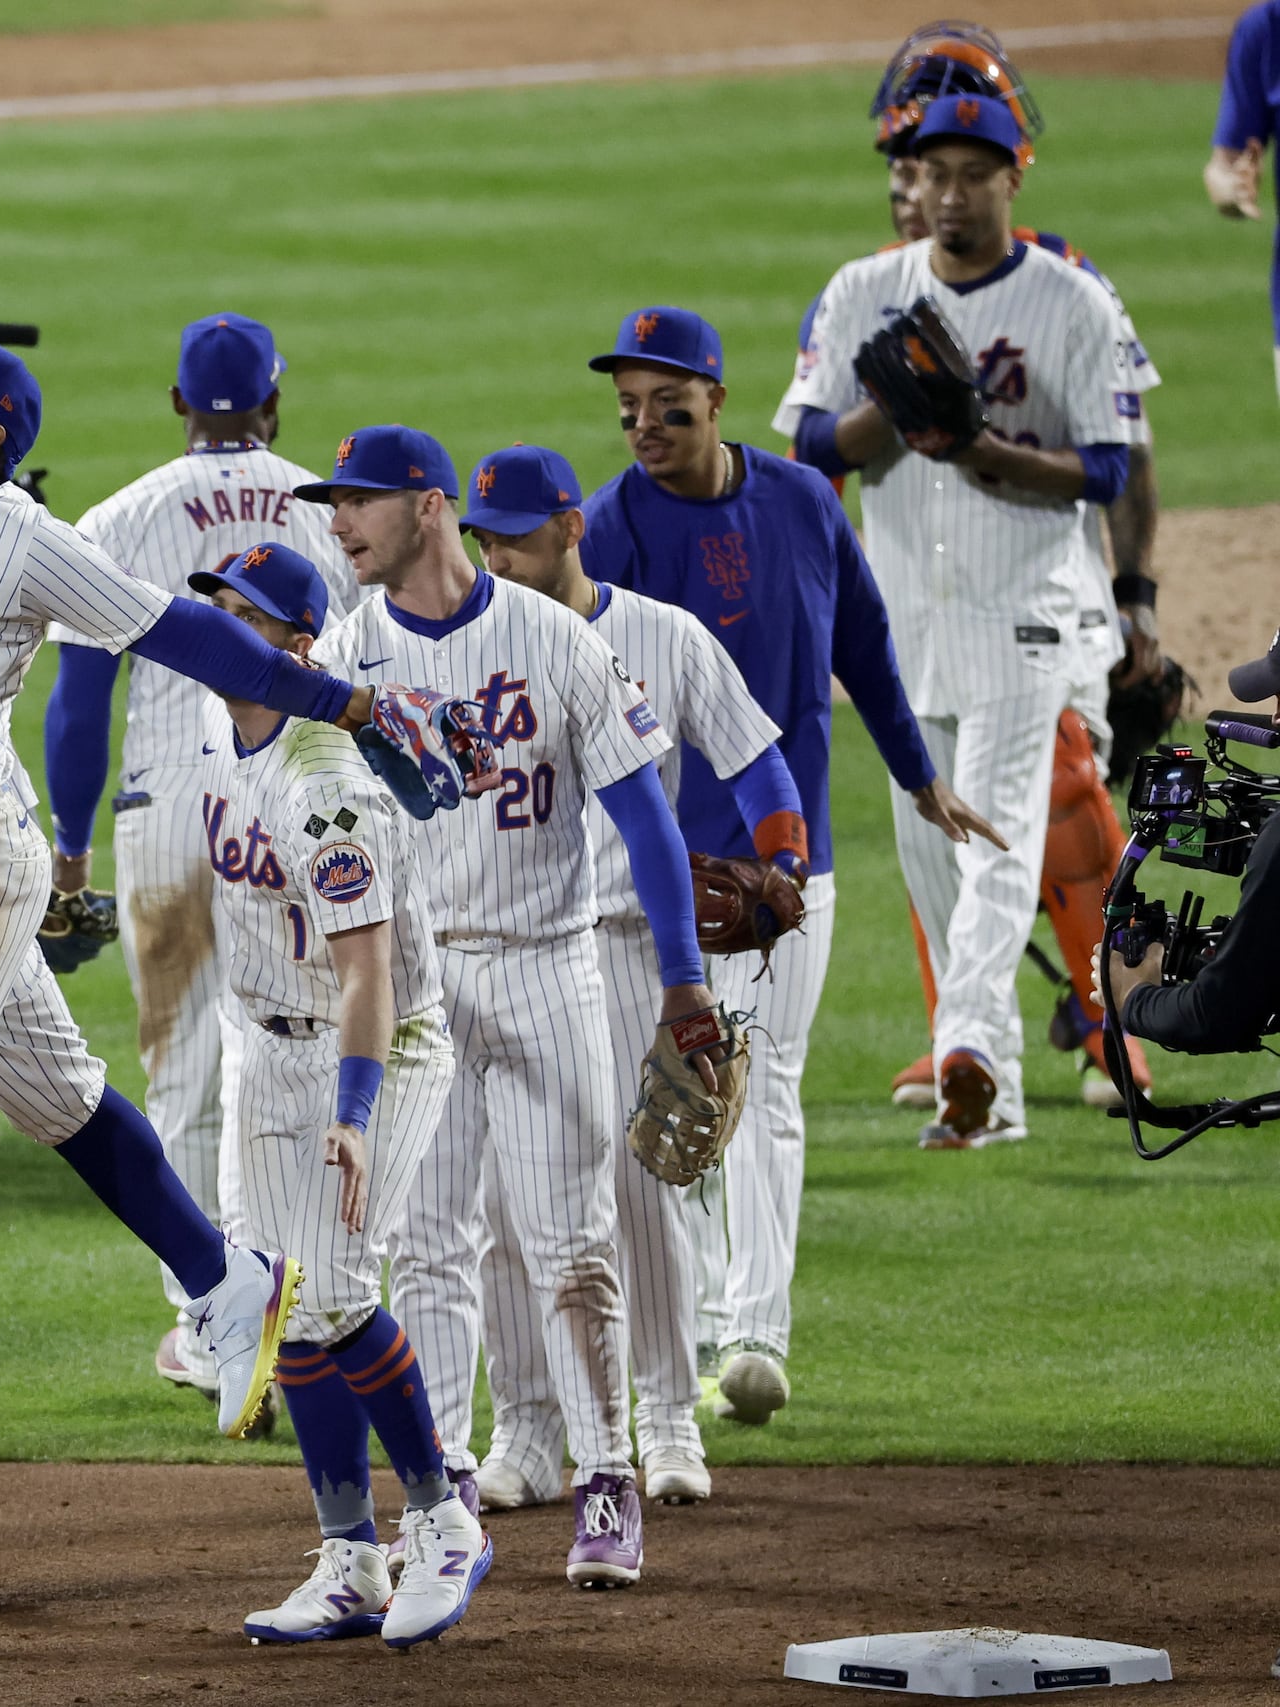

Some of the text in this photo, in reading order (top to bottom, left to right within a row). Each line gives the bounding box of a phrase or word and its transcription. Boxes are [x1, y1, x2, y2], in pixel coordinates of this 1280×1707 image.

[337, 436, 355, 467] NY
[477, 465, 497, 498] NY
[183, 488, 296, 532] MARTE
[699, 532, 751, 600] NY
[475, 670, 538, 748] ts
[496, 761, 556, 832] 20
[323, 862, 363, 889] Mets
[287, 903, 307, 961] 1
